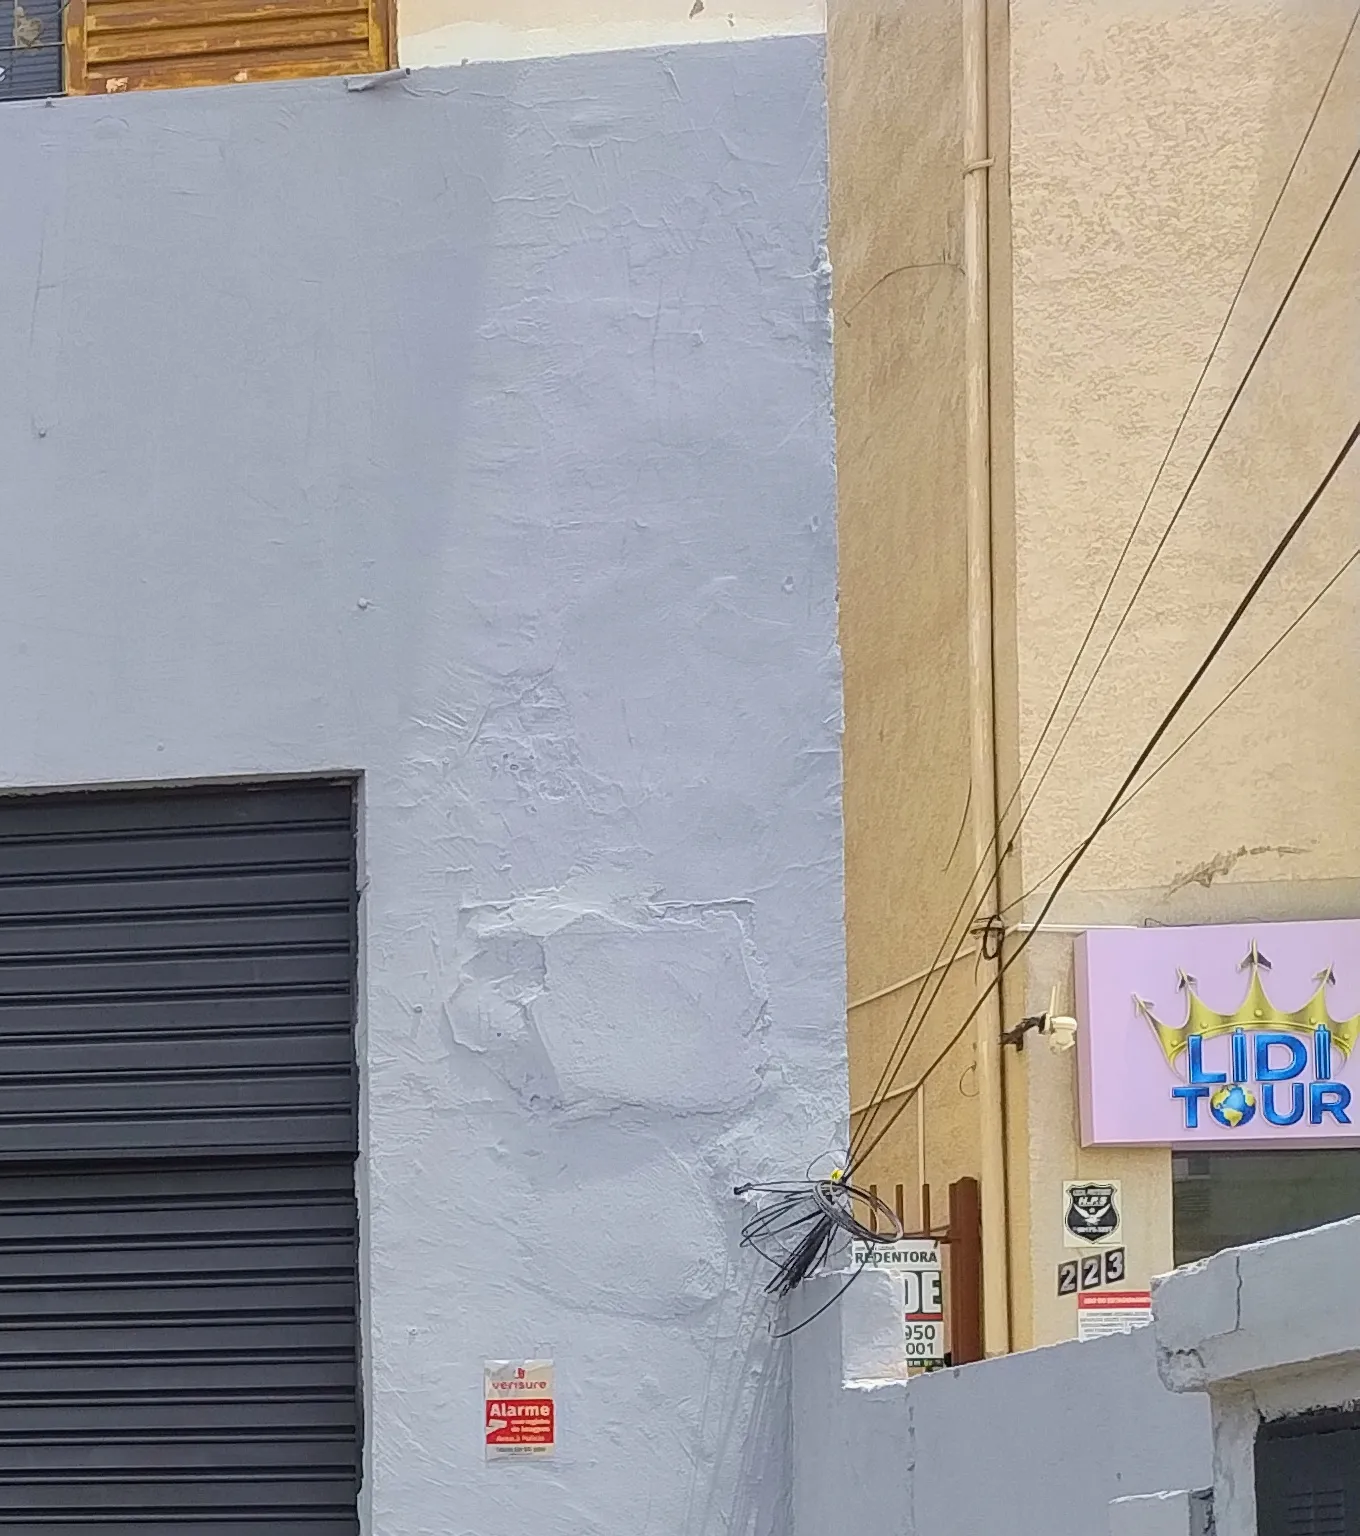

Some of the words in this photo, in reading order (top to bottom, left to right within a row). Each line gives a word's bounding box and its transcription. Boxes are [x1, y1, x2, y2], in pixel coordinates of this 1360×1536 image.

[1188, 1024, 1332, 1084] LIDI
[1171, 1082, 1352, 1128] TOUR
[855, 1250, 938, 1263] REDENTORA
[1060, 1251, 1124, 1292] 223
[491, 1380, 548, 1391] verisure
[490, 1403, 551, 1417] Alarme
